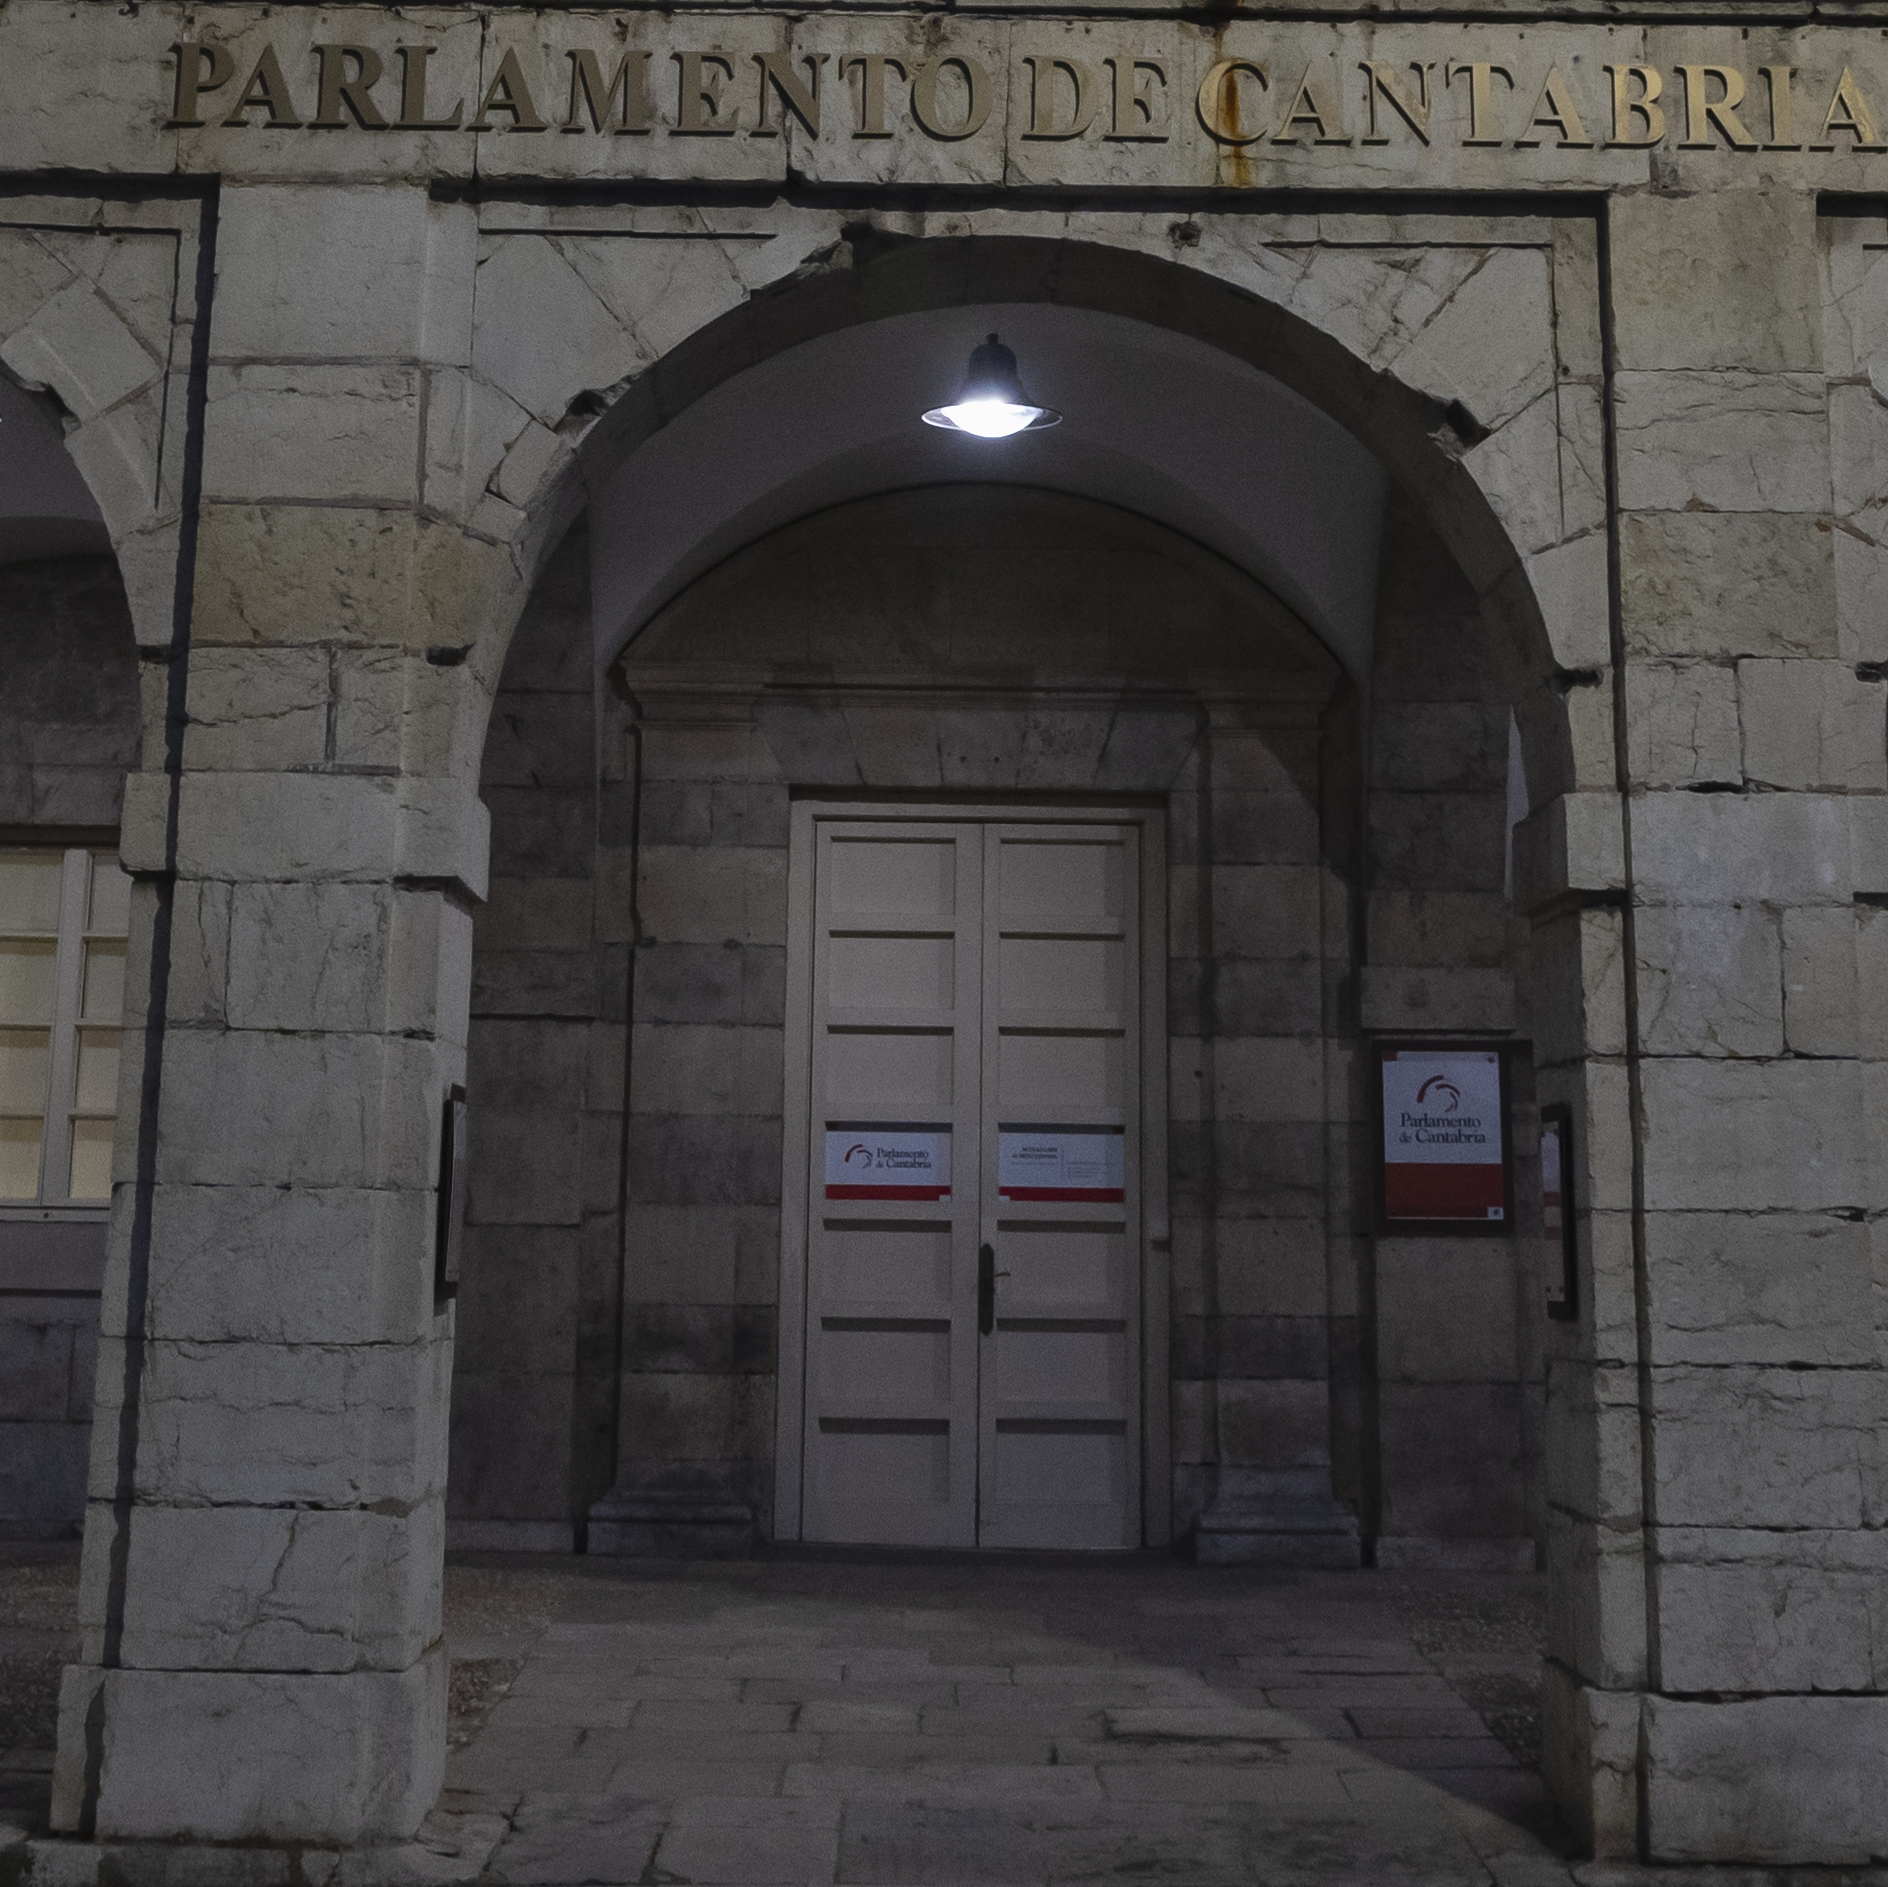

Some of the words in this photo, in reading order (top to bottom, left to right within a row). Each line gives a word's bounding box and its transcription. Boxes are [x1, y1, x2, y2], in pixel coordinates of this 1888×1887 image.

[161, 42, 993, 142] PARLAMENTO
[1022, 56, 1169, 143] DE
[1400, 1113, 1481, 1127] Parlamento
[1399, 1132, 1412, 1143] de
[1415, 1129, 1486, 1143] Cantabria
[876, 1148, 929, 1159] Parlamento
[886, 1159, 931, 1169] Cantabria
